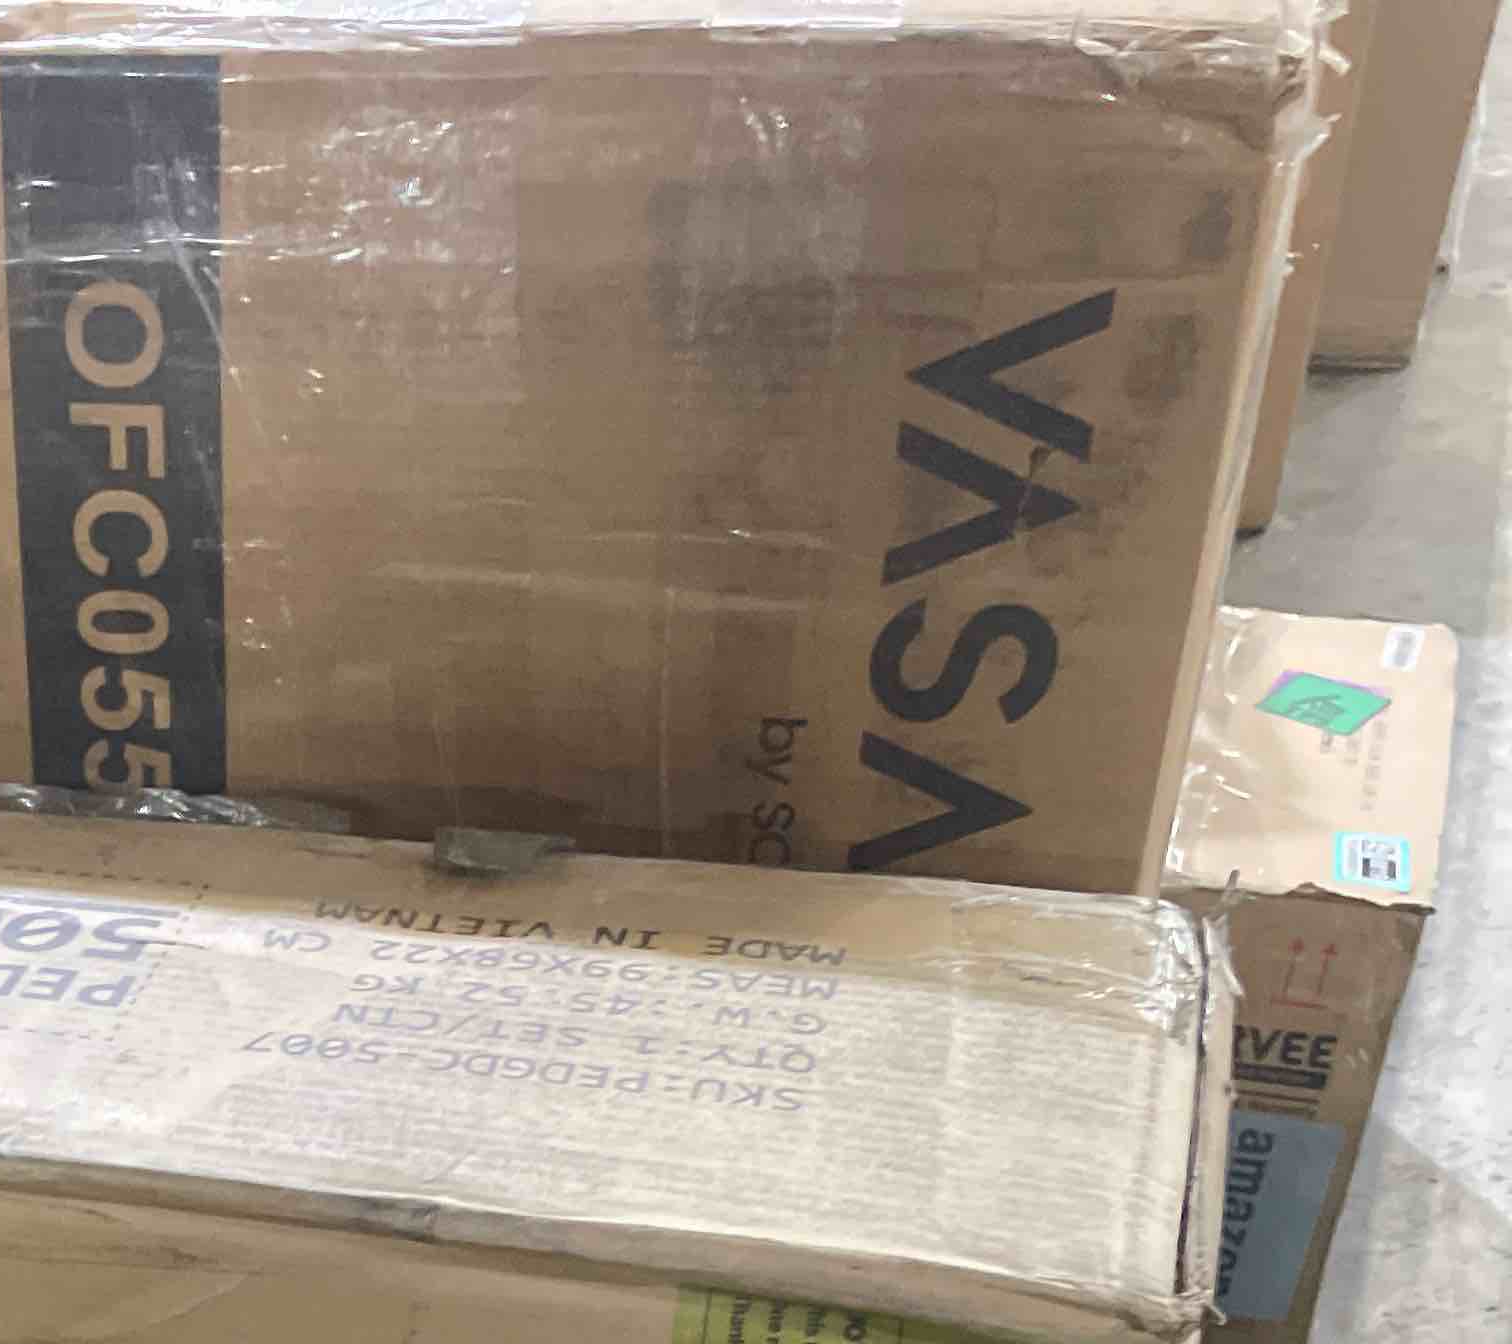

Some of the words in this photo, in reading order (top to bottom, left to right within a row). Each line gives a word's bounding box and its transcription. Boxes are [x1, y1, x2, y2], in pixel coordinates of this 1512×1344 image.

[745, 717, 808, 785] by
[314, 902, 555, 939] VIETNAM
[262, 929, 331, 952] CM
[593, 926, 661, 950] IN
[704, 935, 846, 966] MADE
[348, 973, 425, 995] KG
[332, 1002, 591, 1048] SET/CTN
